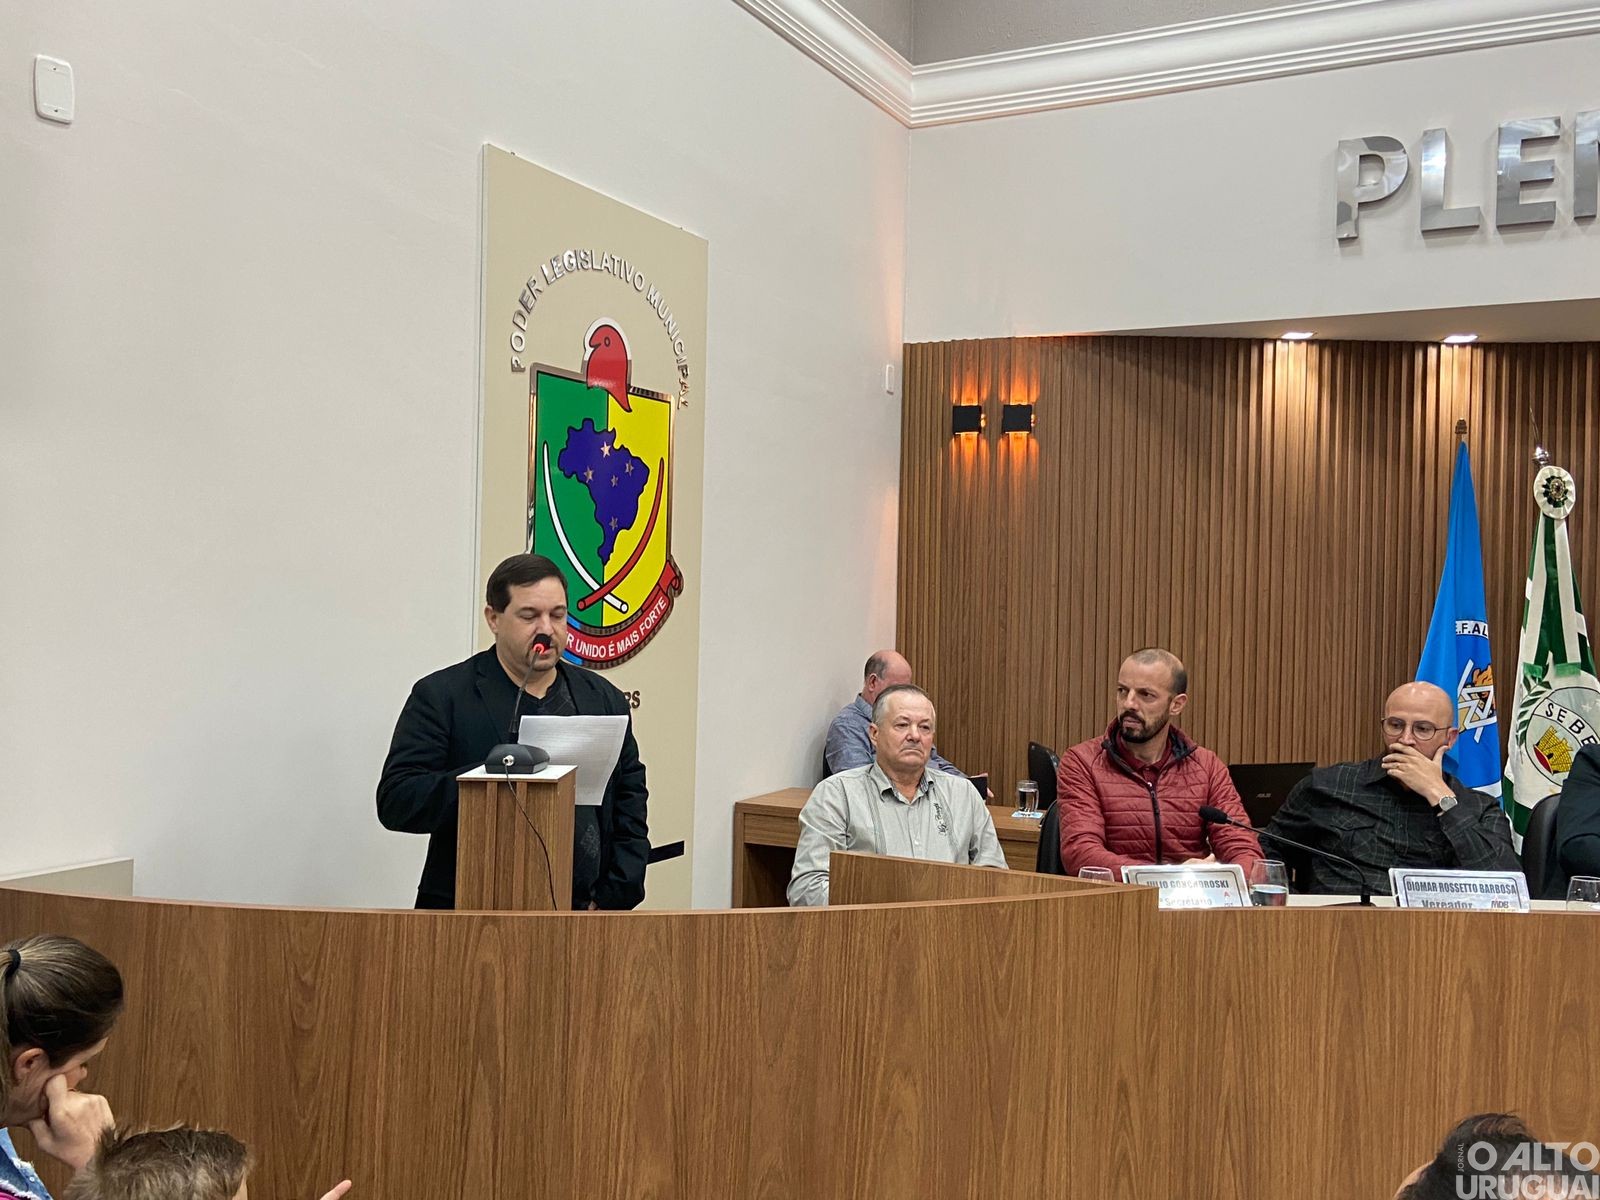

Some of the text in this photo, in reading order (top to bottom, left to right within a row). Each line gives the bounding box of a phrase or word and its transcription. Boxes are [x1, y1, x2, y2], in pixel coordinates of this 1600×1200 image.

[510, 249, 689, 410] PODER LEGISLATIVO MUNICIPAL
[575, 638, 606, 658] UNIDO
[608, 641, 615, 657] É
[617, 631, 640, 654] MAIS
[640, 596, 667, 636] FORTE
[1406, 881, 1518, 895] DIOMAR ROSSETTO BARBOSA
[1421, 899, 1473, 909] Vereador
